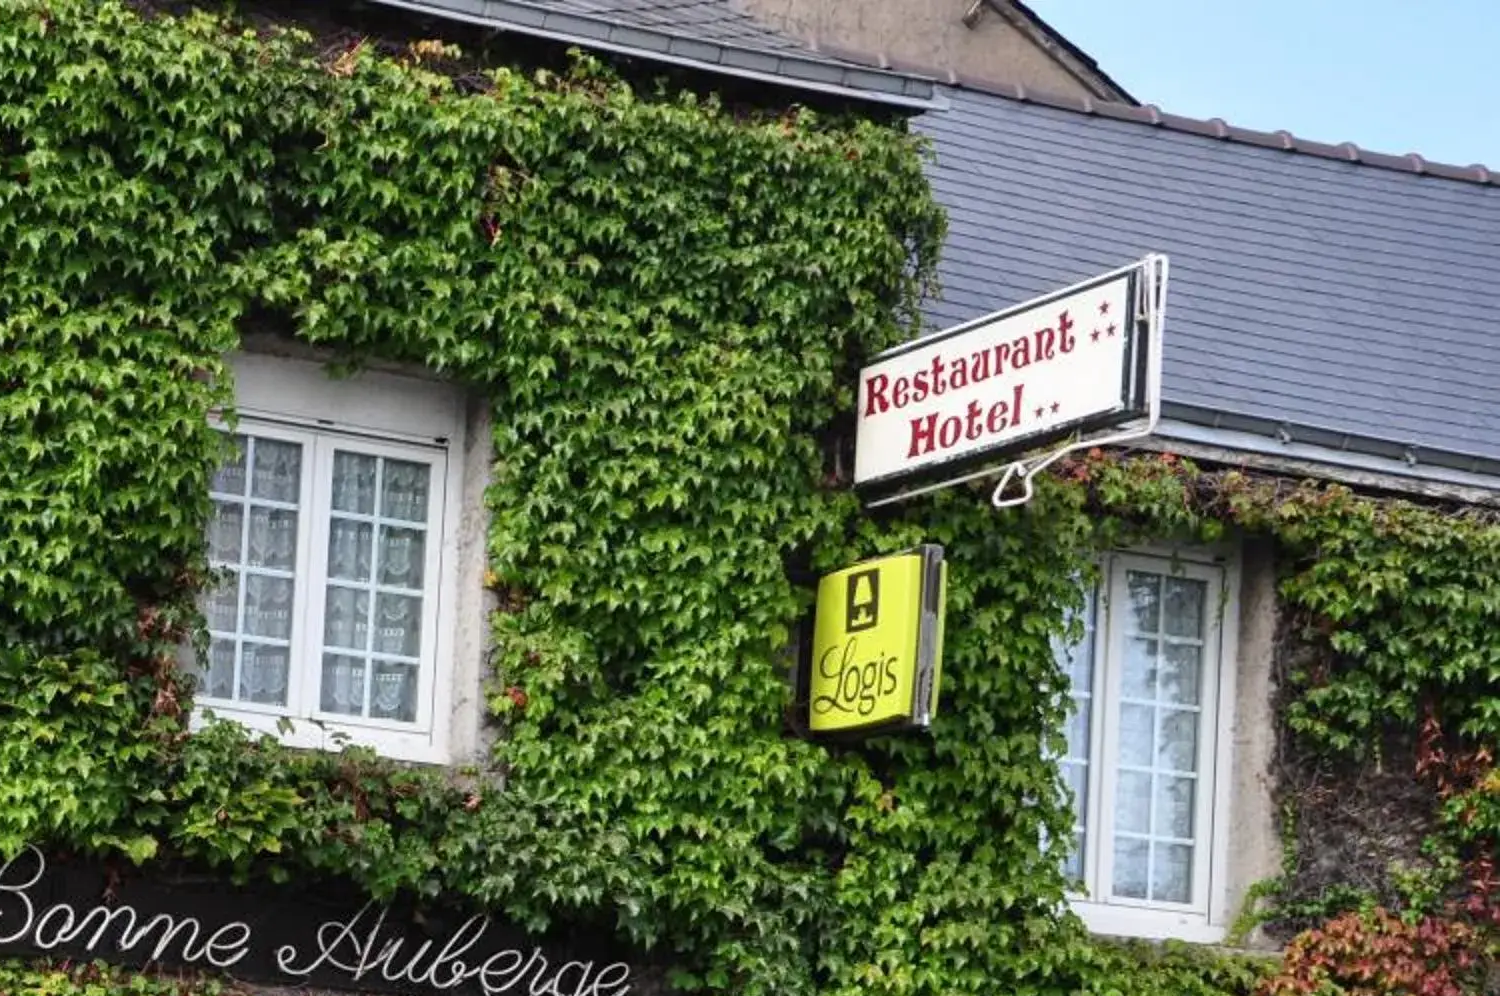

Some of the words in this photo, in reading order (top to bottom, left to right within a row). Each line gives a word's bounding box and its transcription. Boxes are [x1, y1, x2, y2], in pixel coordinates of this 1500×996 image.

[863, 309, 1076, 419] Restaurant
[907, 383, 1026, 459] Hotel
[812, 636, 898, 716] Logis
